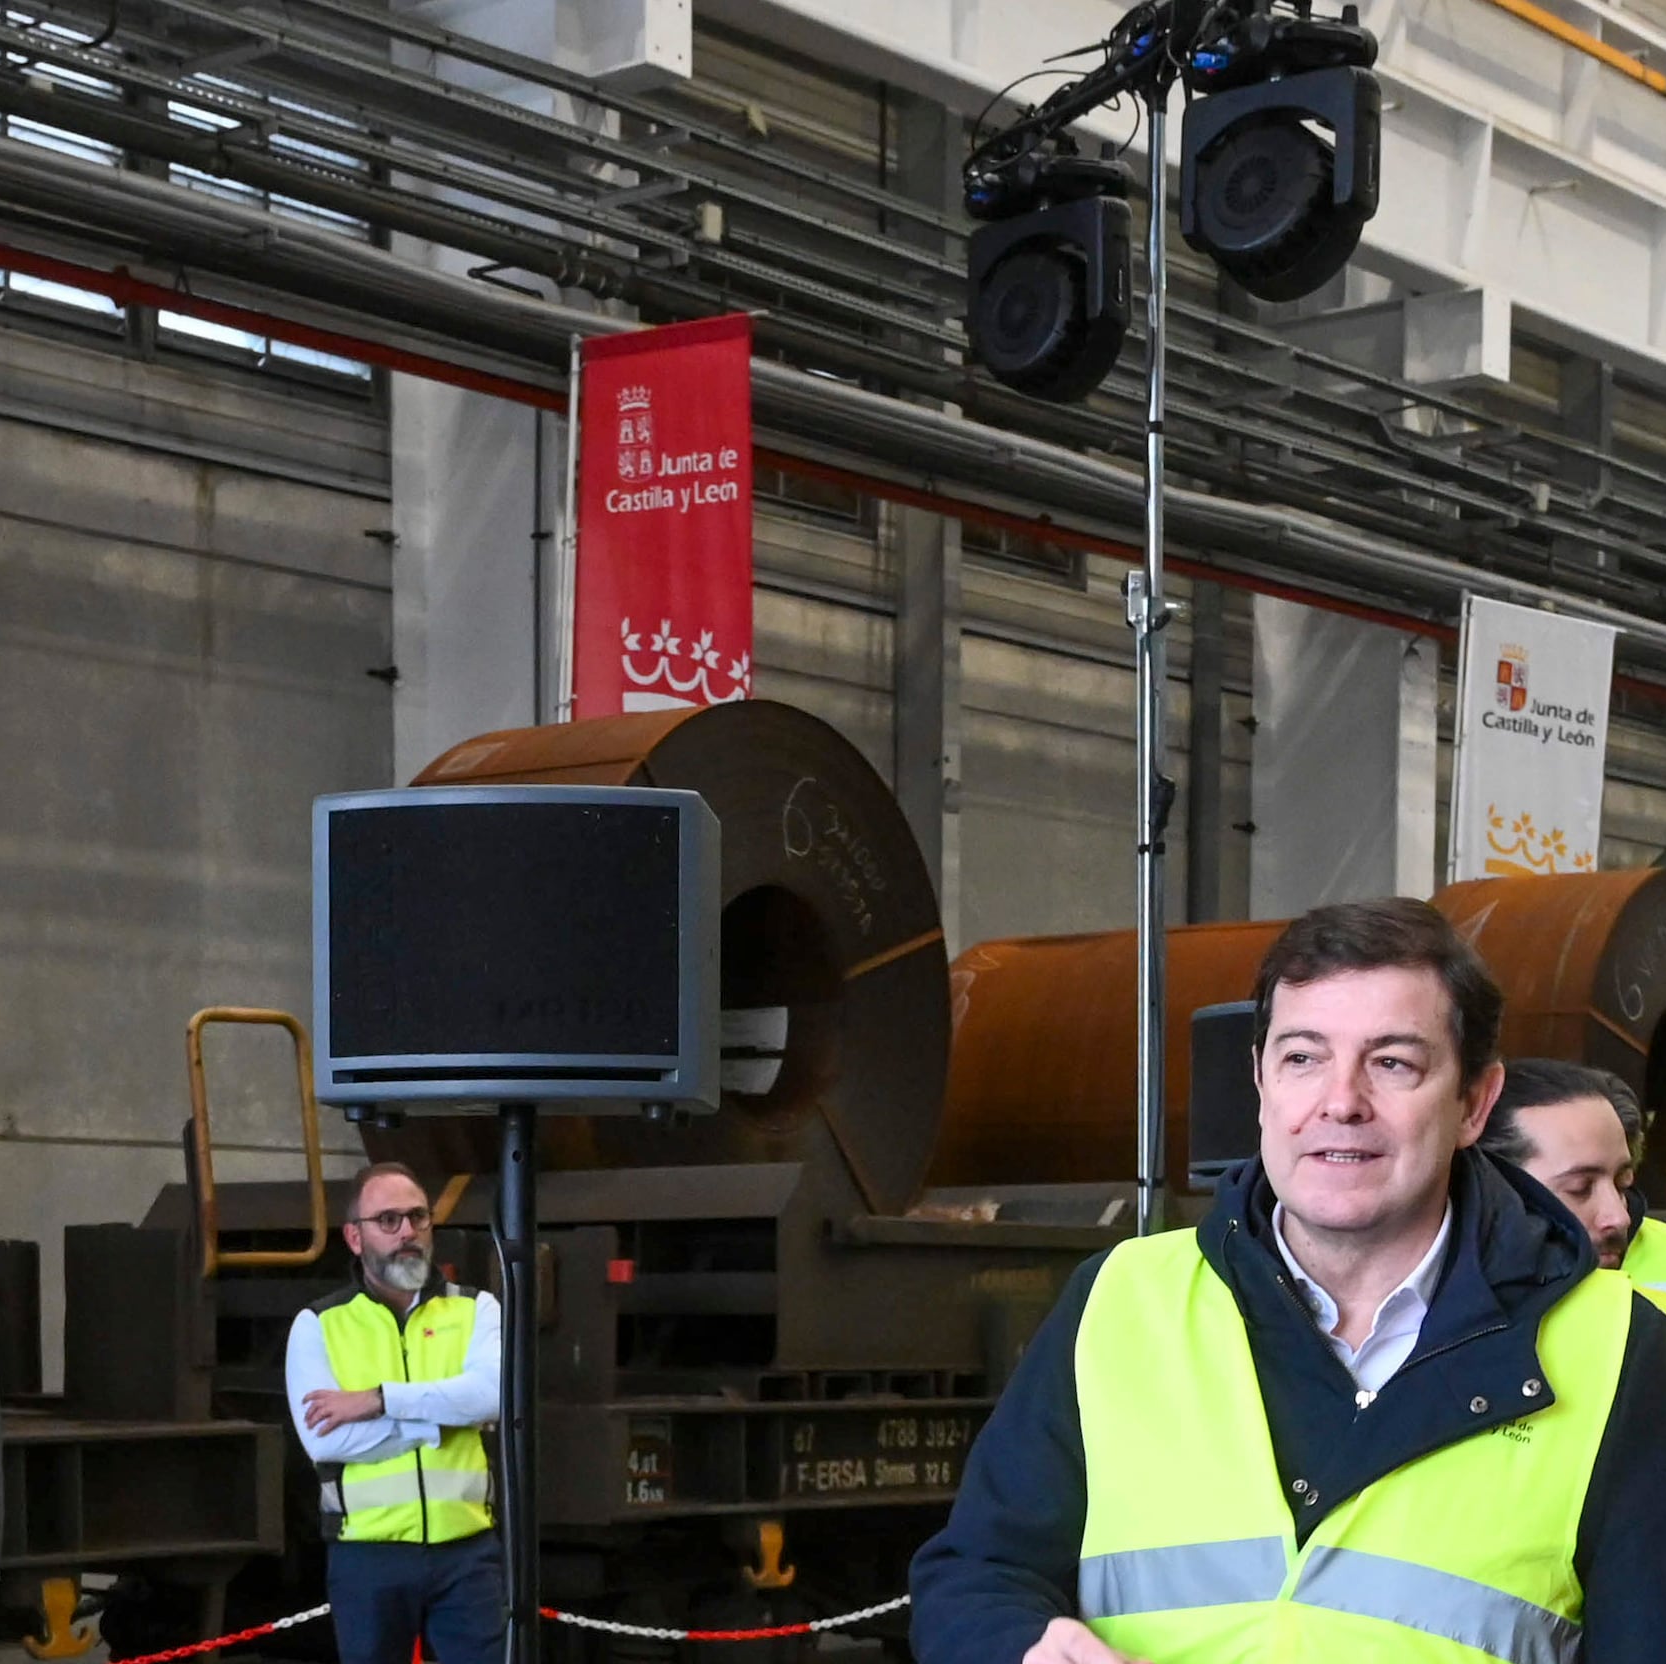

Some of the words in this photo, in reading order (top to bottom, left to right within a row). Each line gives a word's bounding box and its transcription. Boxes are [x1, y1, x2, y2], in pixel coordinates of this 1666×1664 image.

[657, 452, 713, 477] Junta
[719, 446, 738, 469] de
[606, 486, 674, 513] Castilla
[680, 487, 691, 513] y
[694, 478, 738, 504] León
[1530, 699, 1572, 721] Junta
[1575, 707, 1595, 726] de
[1482, 711, 1539, 737] Castilla
[1542, 725, 1553, 744] y
[1558, 725, 1595, 747] León
[1502, 1427, 1531, 1443] León
[797, 1460, 867, 1491] F-ERSA
